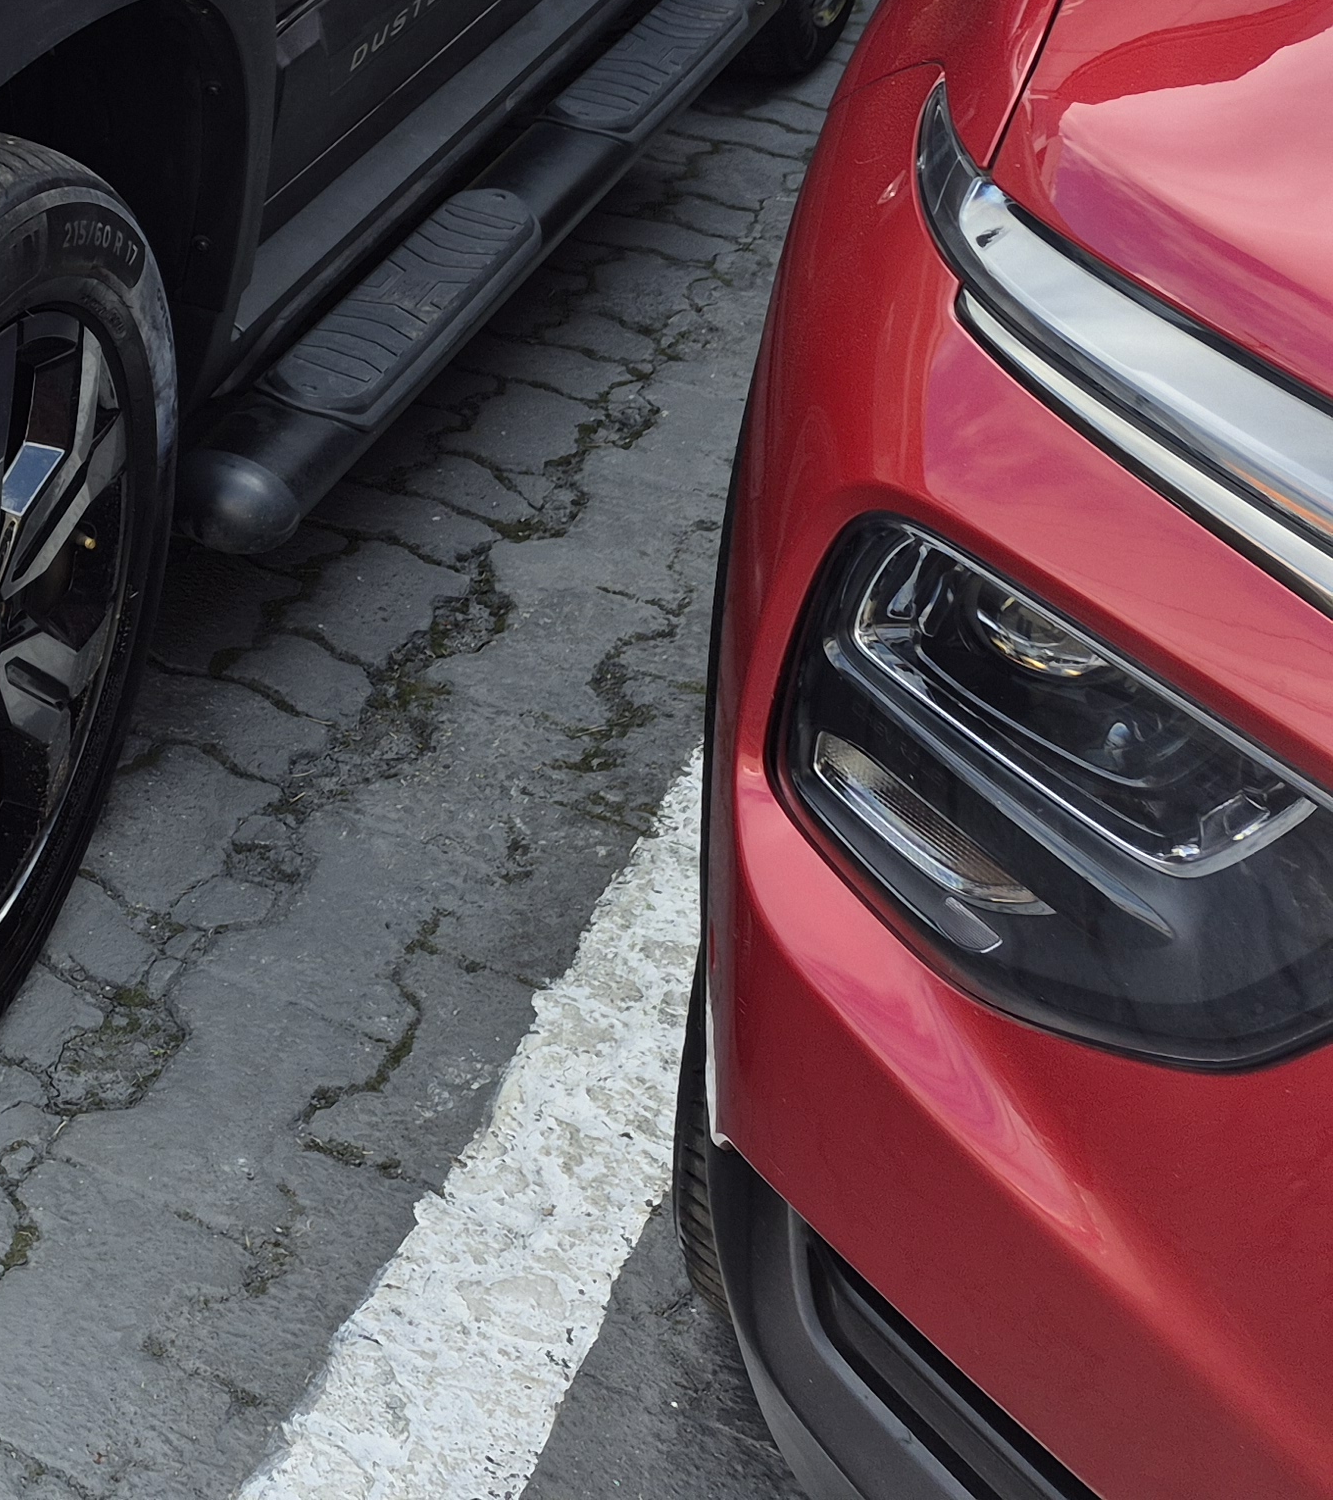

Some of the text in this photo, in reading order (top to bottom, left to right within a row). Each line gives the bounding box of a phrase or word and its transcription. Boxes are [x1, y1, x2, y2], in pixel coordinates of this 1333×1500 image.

[61, 220, 113, 249] 215/60
[112, 232, 126, 256] R
[124, 239, 139, 267] 17
